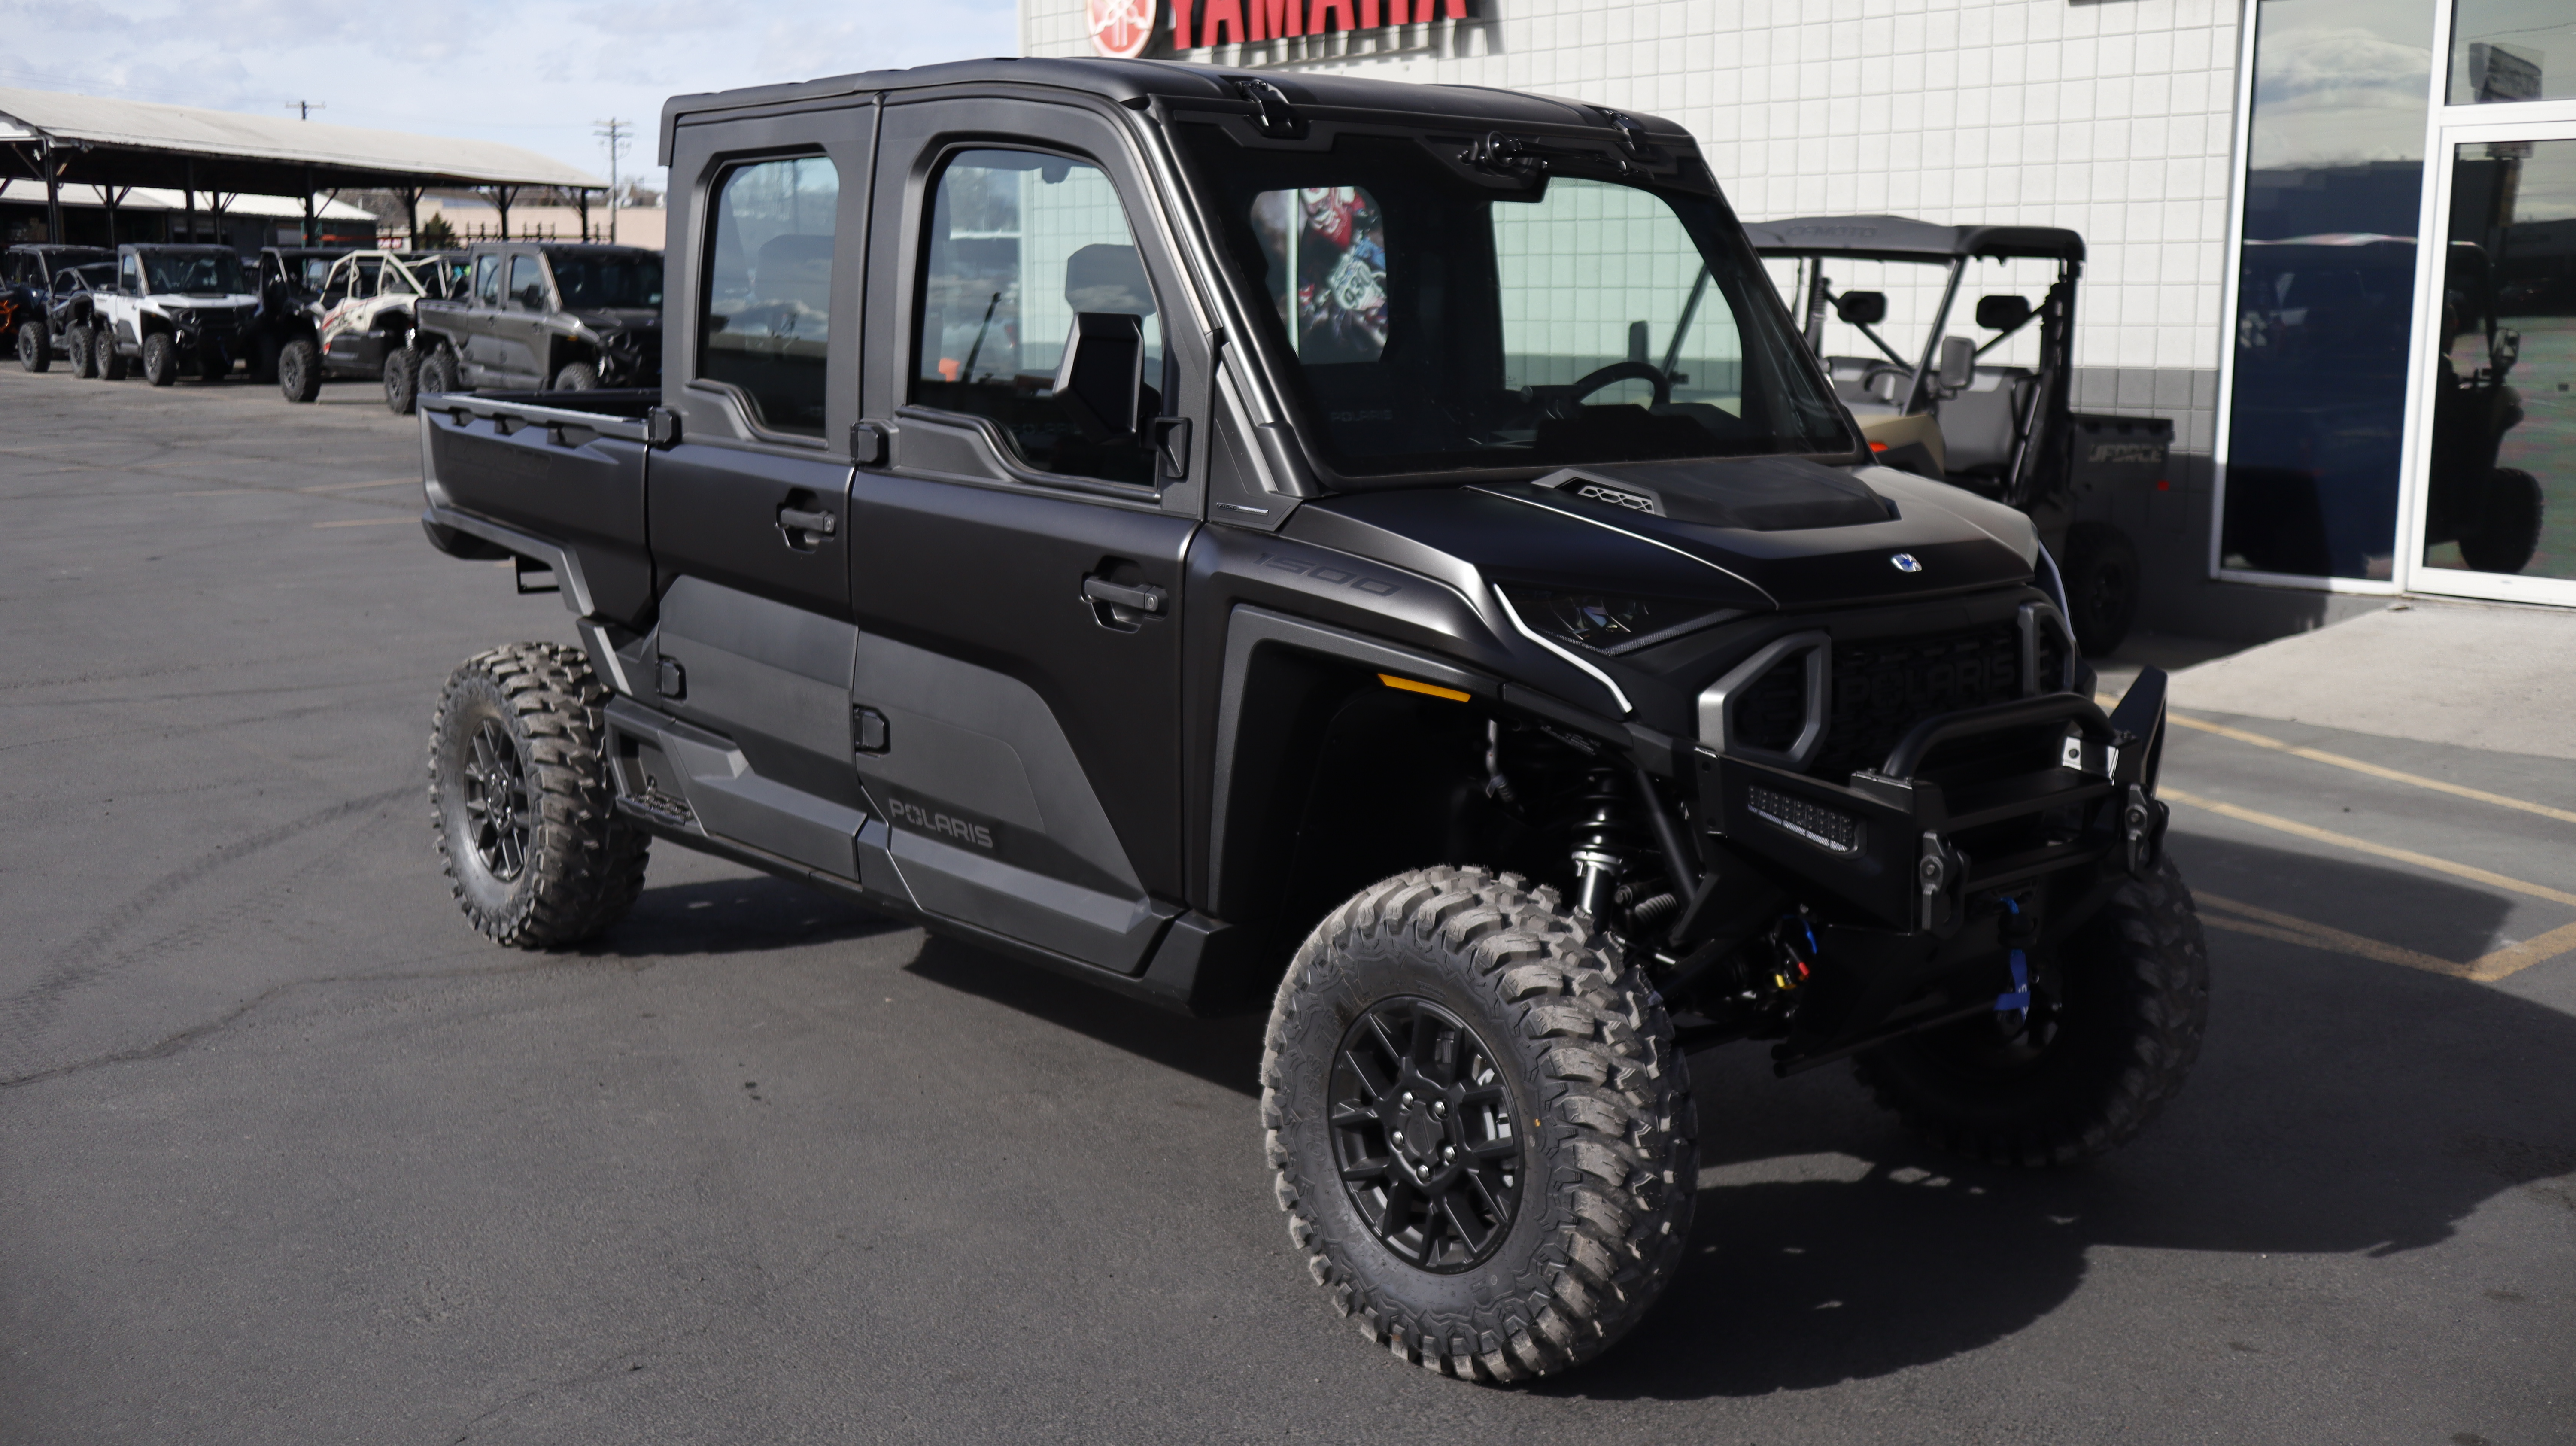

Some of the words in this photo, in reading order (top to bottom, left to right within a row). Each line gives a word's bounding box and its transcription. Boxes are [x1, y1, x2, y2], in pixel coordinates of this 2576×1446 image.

[1173, 0, 1467, 50] YAM
[1330, 409, 1394, 423] POLARIS
[1253, 553, 1402, 597] 1500
[1838, 651, 2016, 714] POLARIS
[888, 798, 993, 848] POLARIS
